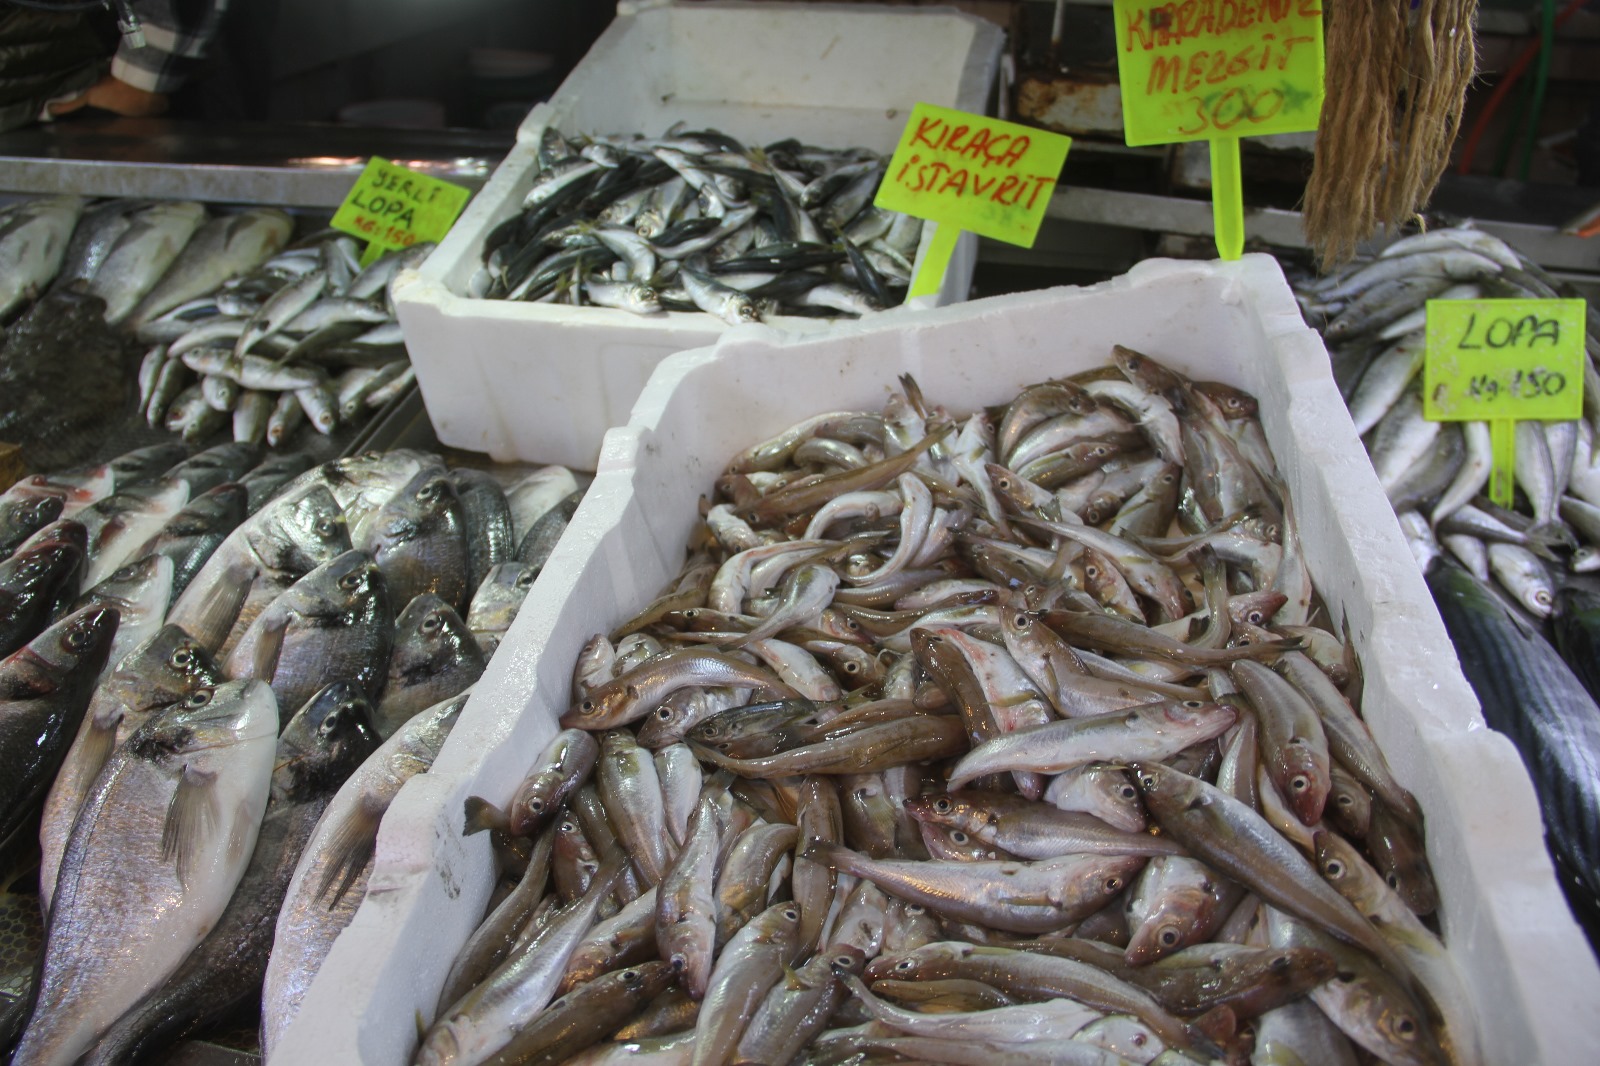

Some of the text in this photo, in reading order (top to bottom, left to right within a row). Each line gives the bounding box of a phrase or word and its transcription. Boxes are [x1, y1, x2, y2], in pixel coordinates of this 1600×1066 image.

[909, 116, 1031, 168] KIRAÇA
[350, 189, 415, 229] LOPA
[1458, 312, 1560, 349] LOPA
